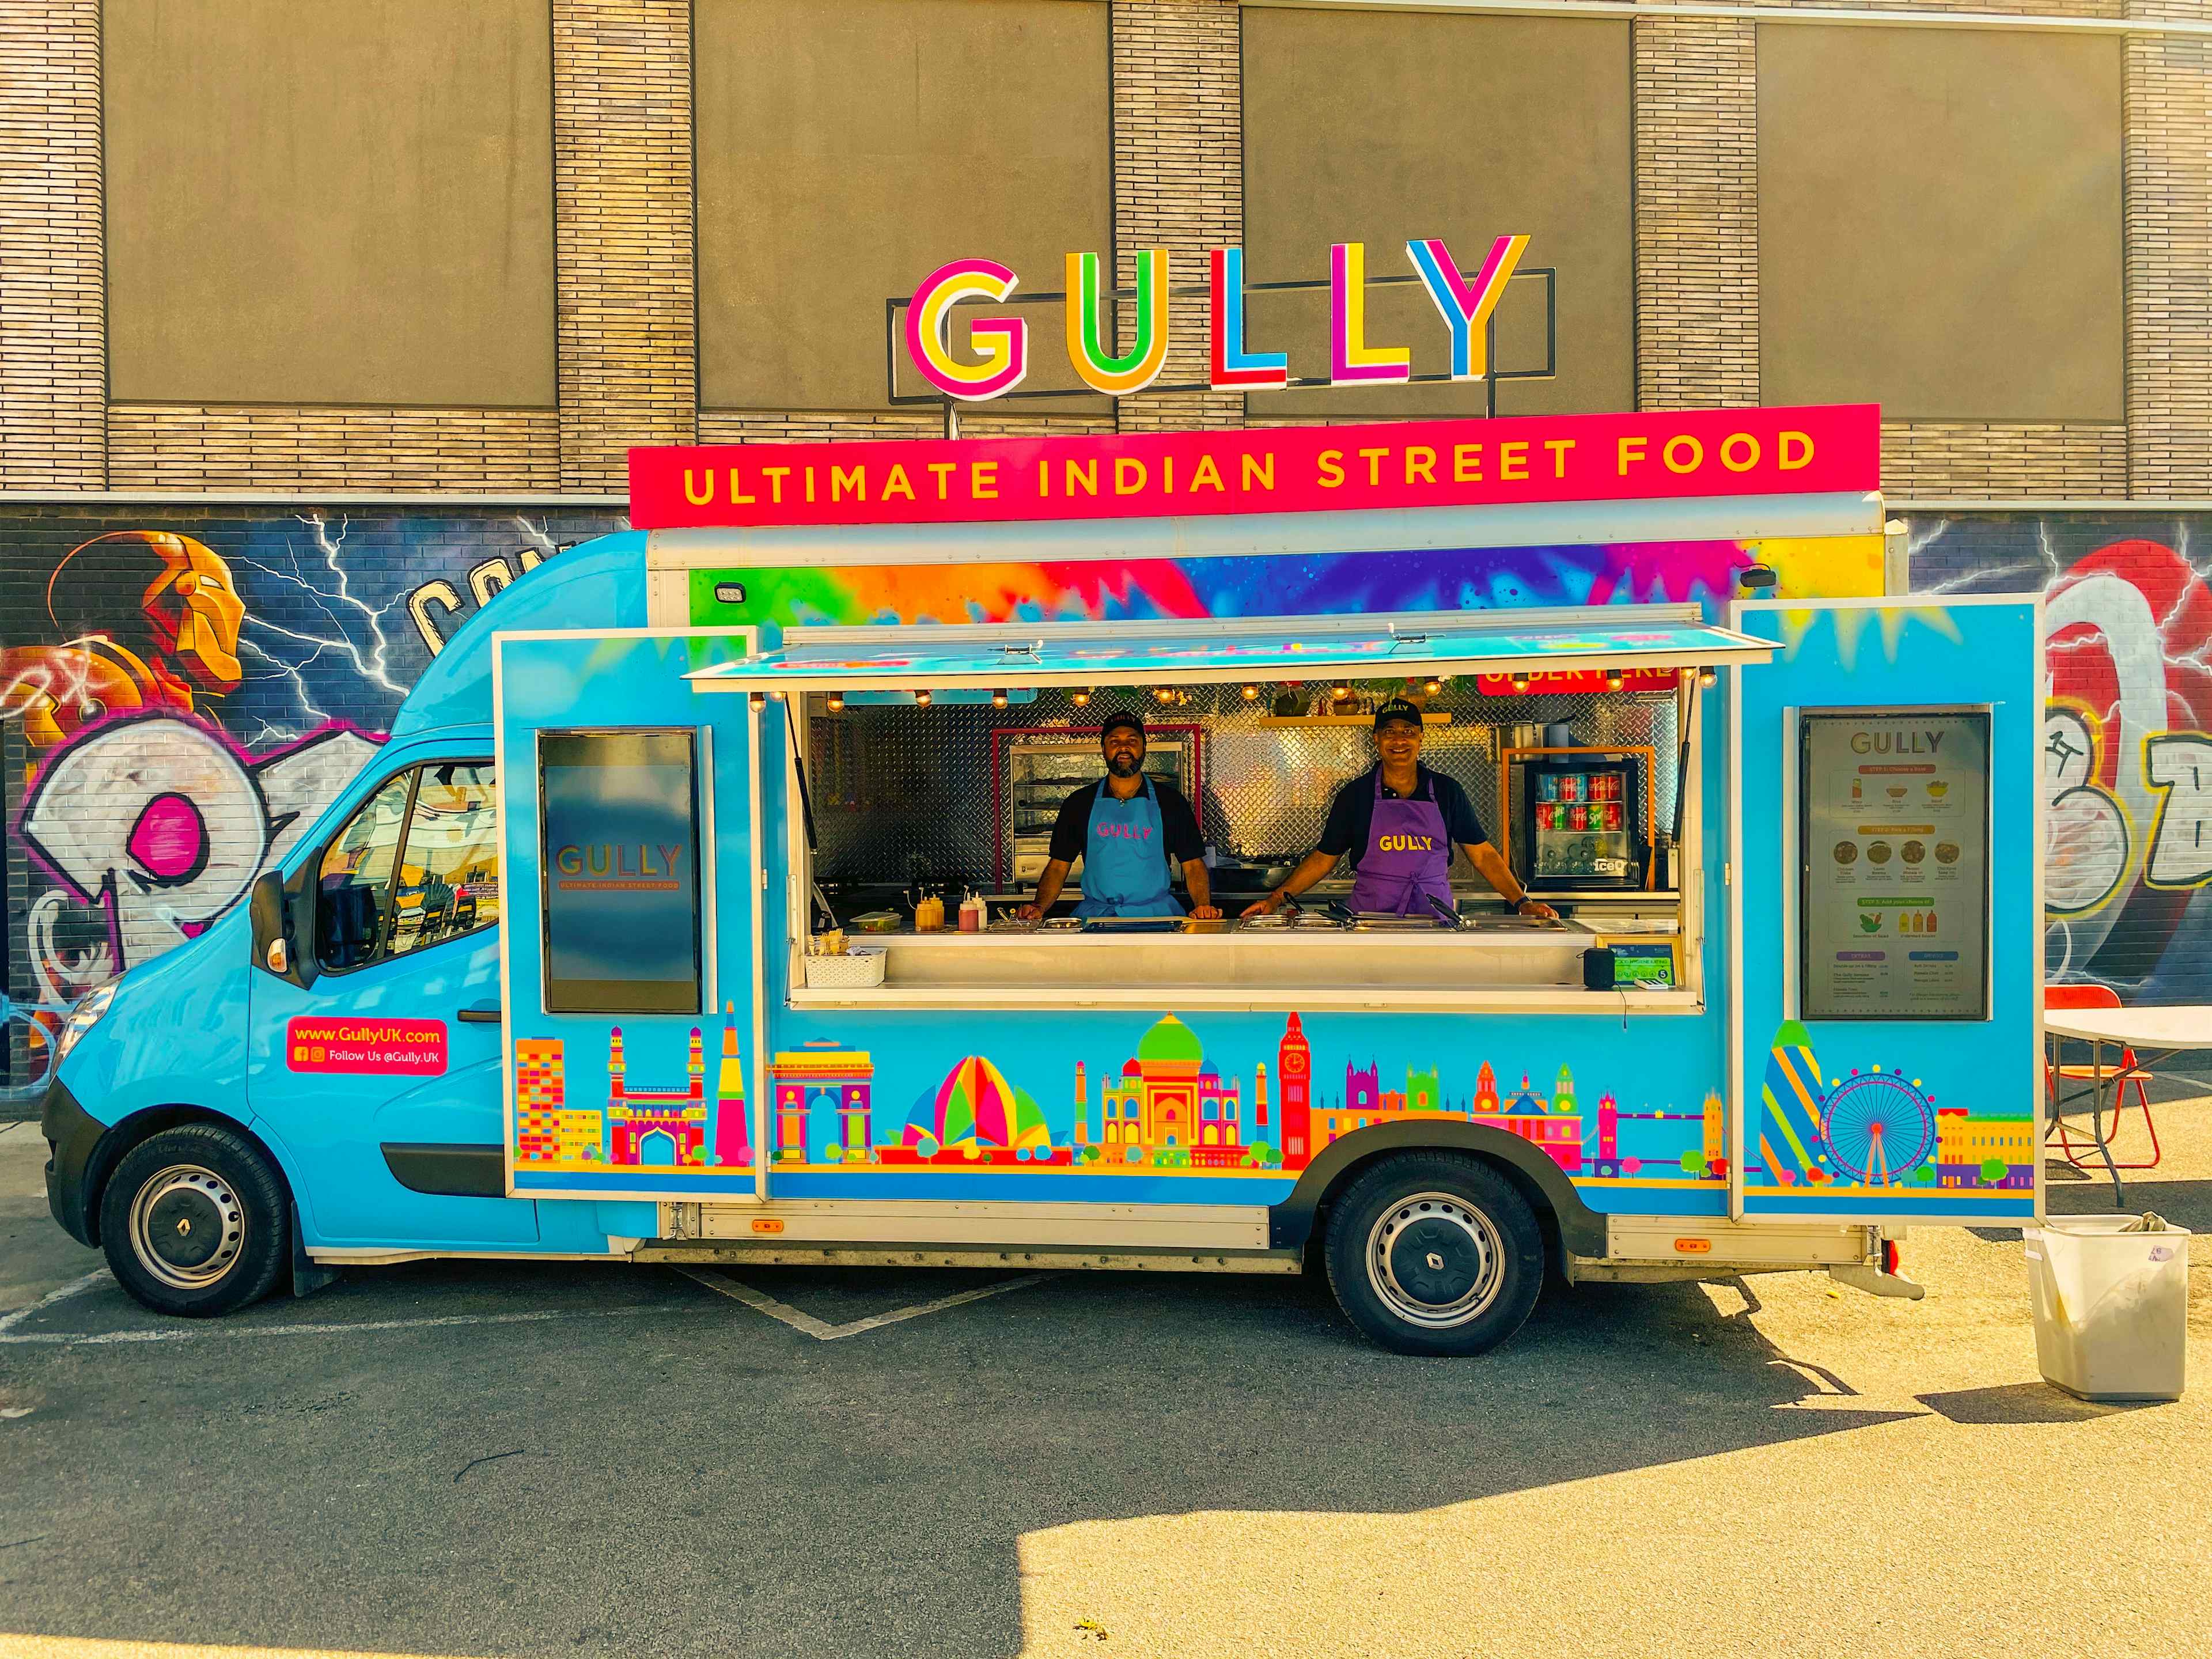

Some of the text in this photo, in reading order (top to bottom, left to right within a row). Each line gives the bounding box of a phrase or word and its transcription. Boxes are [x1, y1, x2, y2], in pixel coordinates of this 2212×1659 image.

[906, 234, 1531, 402] GULLY
[684, 431, 1815, 505] ULTIMATE INDIAN STREET FOOD
[1850, 731, 1945, 754] GULLY
[1096, 821, 1153, 839] GULLY
[1379, 835, 1433, 851] GULLY
[555, 844, 683, 876] GULLY
[295, 1027, 440, 1045] www.GullyUK.com
[329, 1050, 440, 1065] Follow Us @Gully.UK
